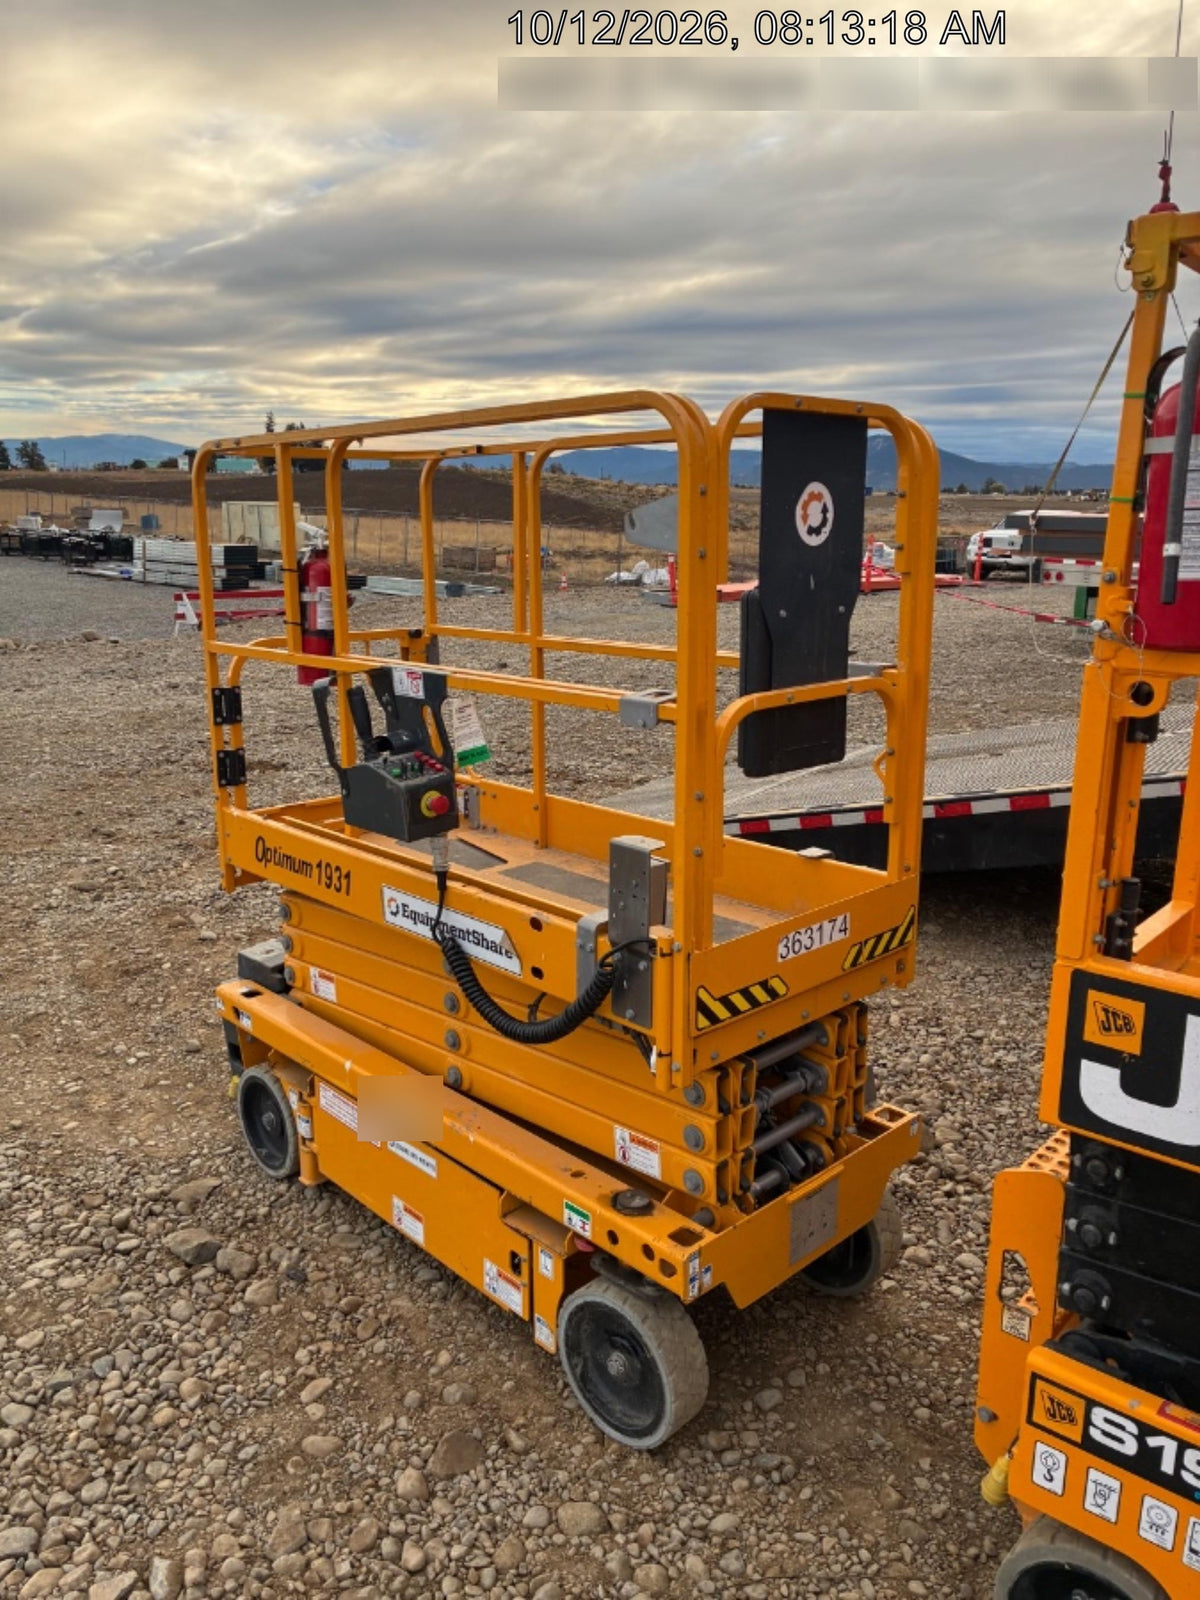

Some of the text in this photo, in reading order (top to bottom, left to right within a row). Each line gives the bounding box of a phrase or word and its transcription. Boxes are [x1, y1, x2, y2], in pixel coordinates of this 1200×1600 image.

[255, 836, 351, 896] Optimum 1931
[779, 915, 849, 960] 363174
[1100, 1006, 1133, 1034] JCB
[1046, 1396, 1076, 1423] JCB
